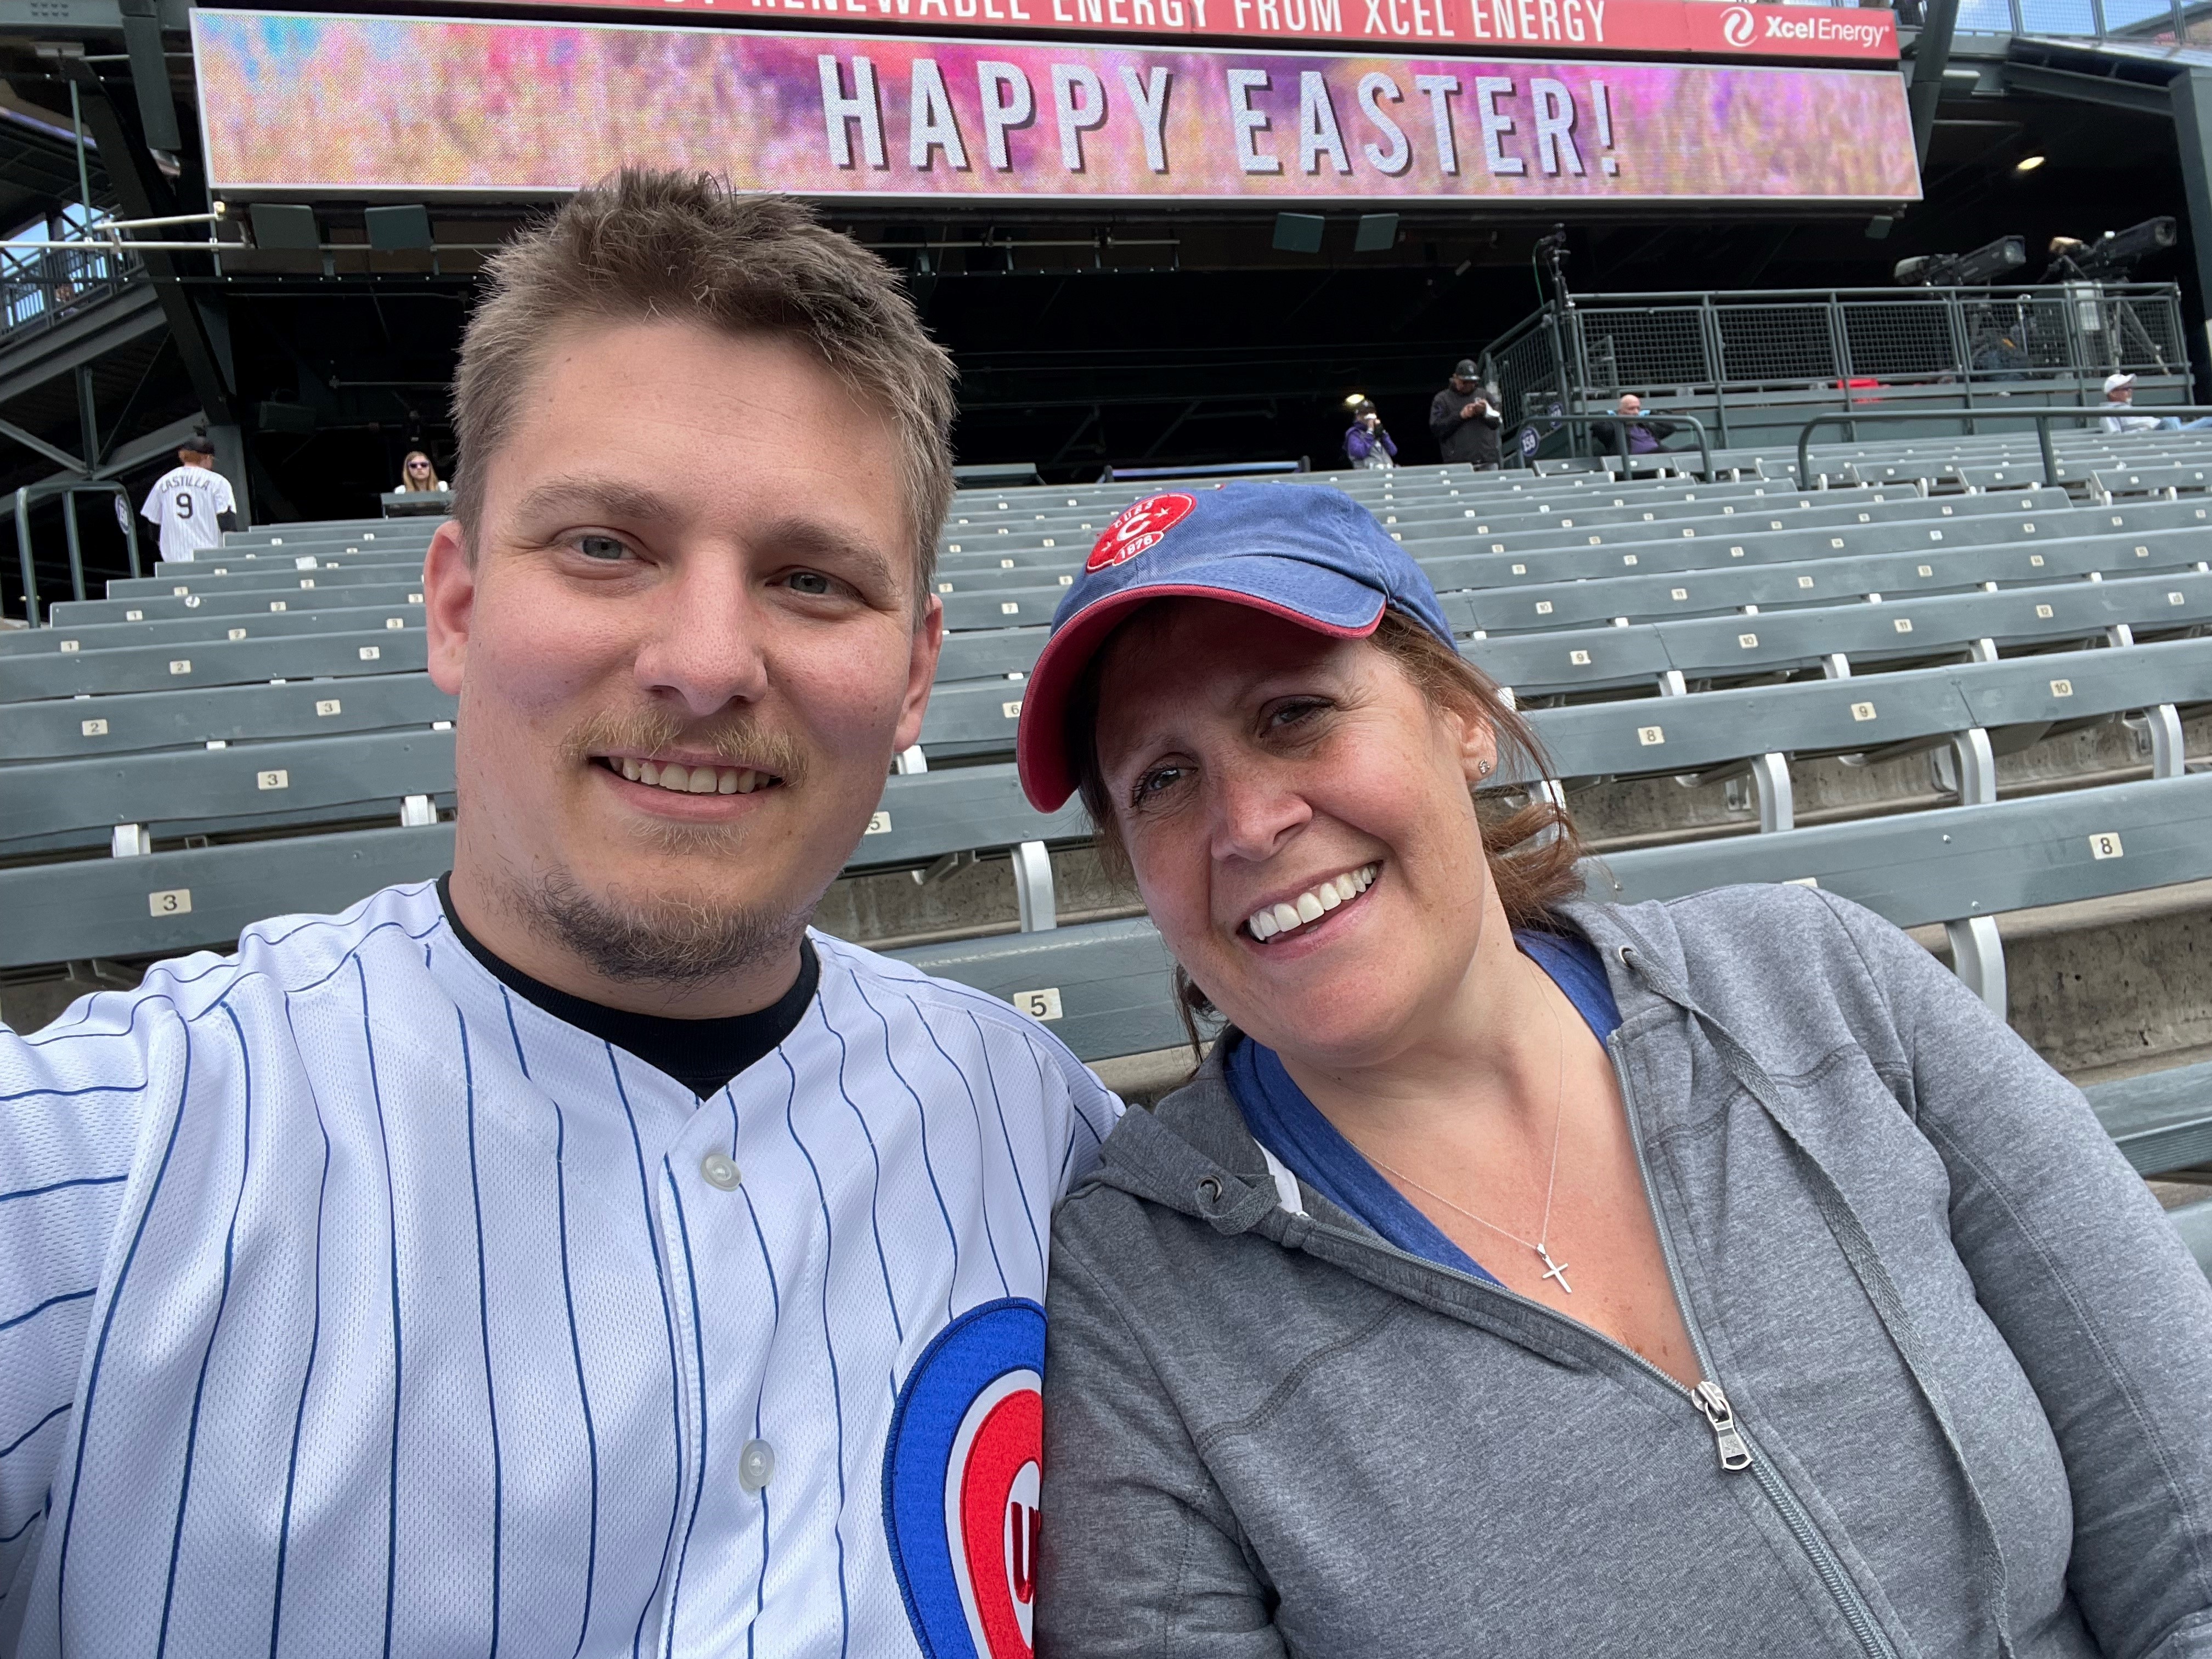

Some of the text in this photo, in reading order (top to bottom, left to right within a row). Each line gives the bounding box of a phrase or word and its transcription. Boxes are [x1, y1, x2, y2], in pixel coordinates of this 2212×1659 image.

[1234, 0, 1342, 32] FROM
[1364, 0, 1455, 37] XCEL
[1471, 0, 1605, 42] ENERGY
[818, 54, 1617, 175] HAPPY EASTER!
[160, 475, 210, 493] CASTILLA
[176, 493, 193, 519] 9
[1120, 534, 1154, 559] 1876
[2056, 683, 2069, 693] 10
[325, 703, 332, 713] 3
[1011, 706, 1019, 714] 6
[1859, 706, 1869, 718] 9
[91, 723, 99, 732] 2
[1646, 729, 1656, 742] 8
[268, 774, 278, 786] 3
[2100, 837, 2113, 855] 8
[163, 895, 178, 911] 3
[1031, 995, 1047, 1017] 5
